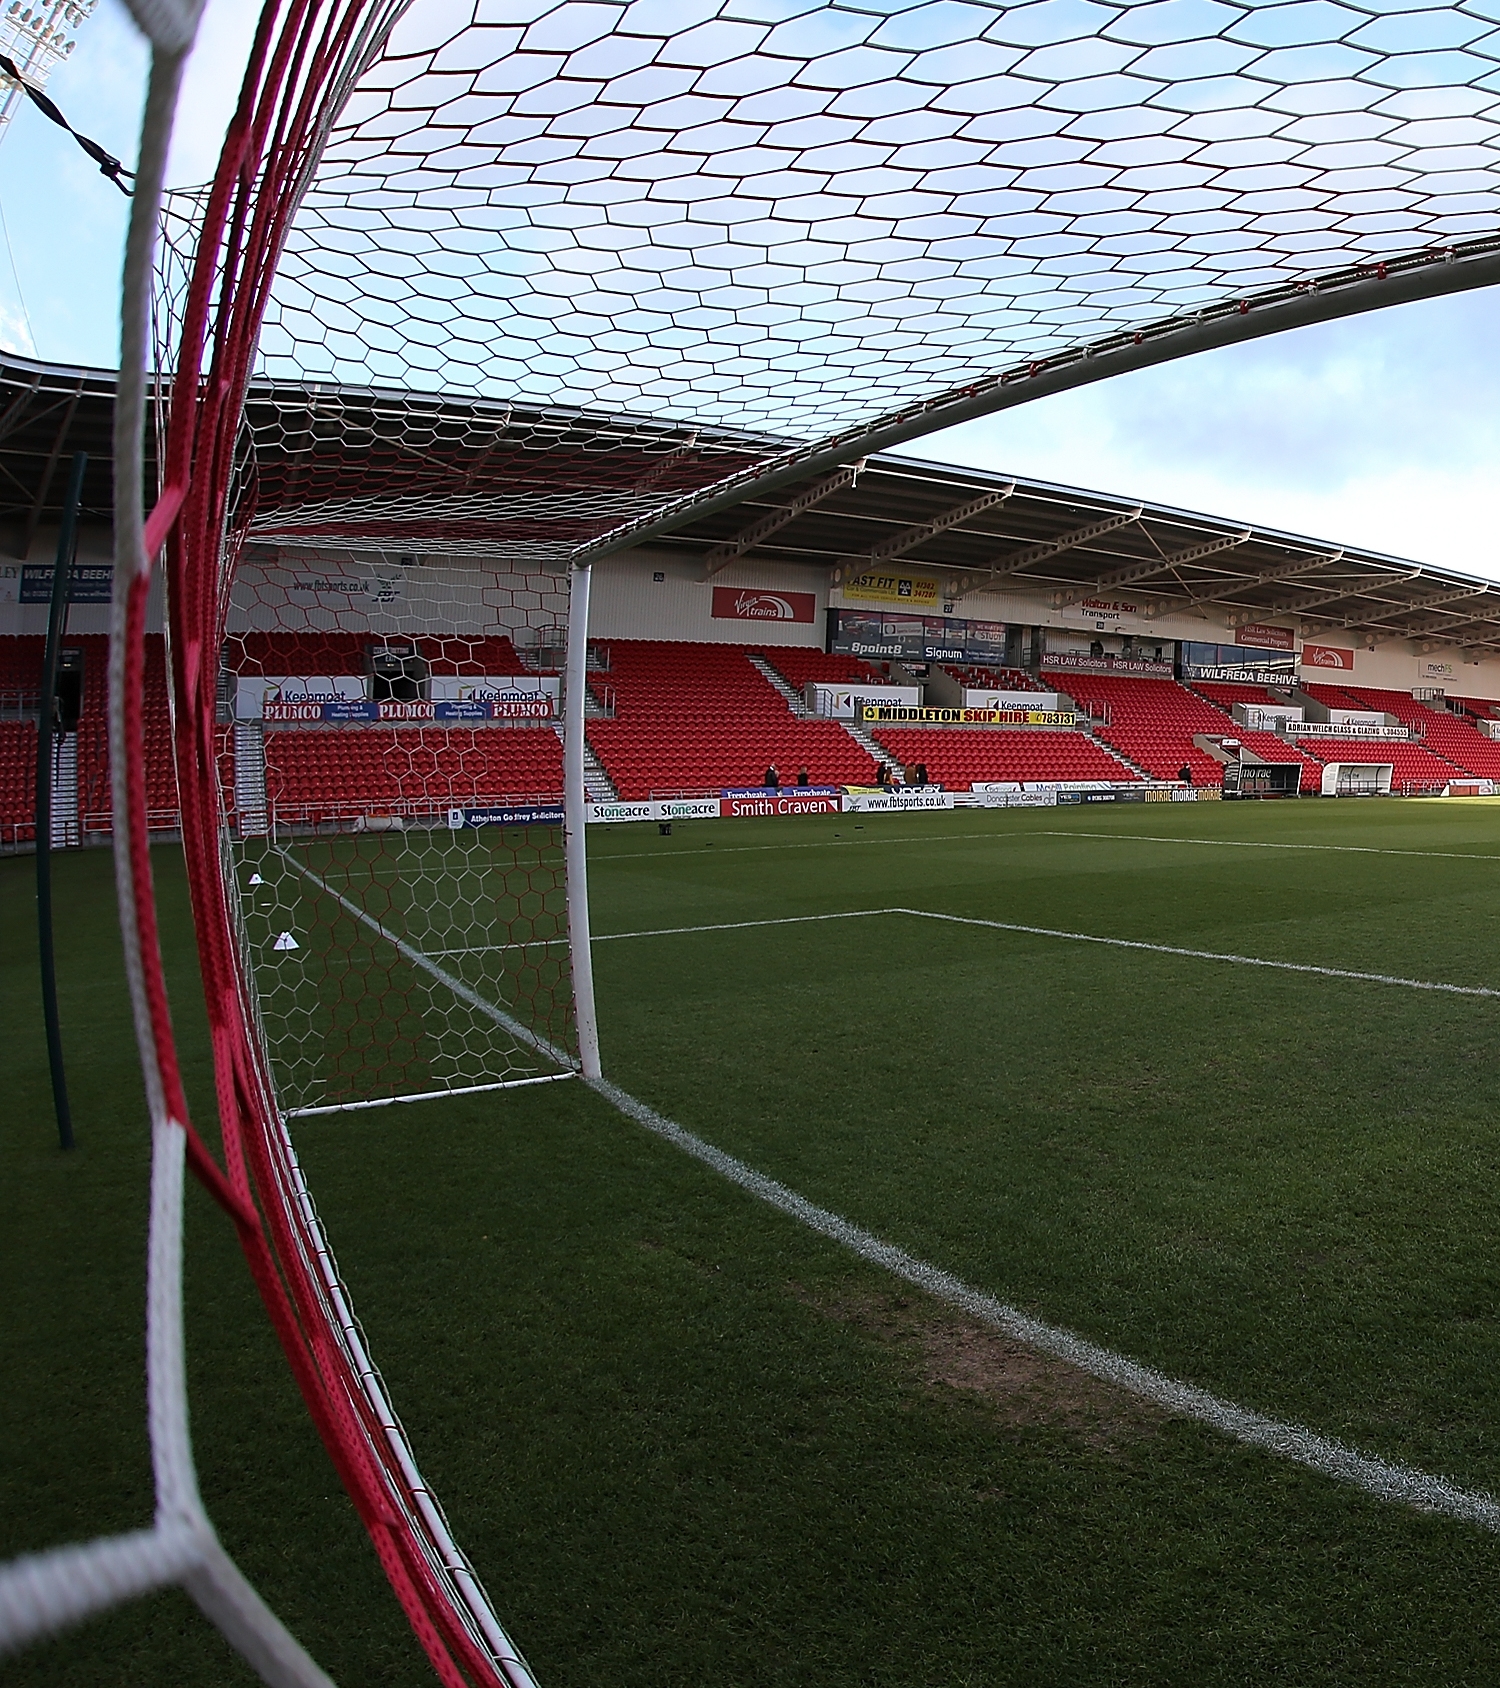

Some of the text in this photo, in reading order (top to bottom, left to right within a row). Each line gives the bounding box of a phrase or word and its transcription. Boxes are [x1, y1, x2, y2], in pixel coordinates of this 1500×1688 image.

[24, 569, 79, 579] WILFRA
[848, 575, 895, 588] AST FIT
[734, 591, 760, 616] Virgin
[1112, 601, 1119, 610] &
[1121, 602, 1137, 613] Son
[749, 606, 777, 617] trains
[1081, 608, 1121, 620] Transport
[851, 642, 903, 655] 8point8
[925, 646, 963, 659] Signum
[1043, 655, 1108, 669] HSR LAW Solicitors
[1112, 660, 1172, 674] HSR LAW Solicitors
[1200, 667, 1299, 686] WILFREDA BEEHIVE
[854, 696, 903, 707] Kepmoat
[264, 705, 322, 720] PLUMCO
[379, 703, 435, 719] PLUMCO
[493, 703, 549, 718] PLUMCO
[878, 707, 1075, 724] MIDDLETON SKIP HIRE 783731
[1288, 723, 1311, 732] ADRIAN
[1312, 724, 1332, 733] WELCH
[1333, 725, 1352, 733] GLASS
[1357, 726, 1380, 735] GLAZING
[1241, 768, 1272, 778] morae
[867, 795, 946, 809] www.fbtsports.co.uk
[1020, 793, 1043, 802] Cables
[1144, 790, 1172, 803] MOIRAE
[1172, 789, 1198, 802] MOIRAE
[1198, 789, 1223, 801] MOIRAE
[593, 805, 650, 818] Stoneacre
[660, 803, 716, 816] Stoneacre
[731, 798, 827, 817] Smith Craven
[502, 812, 531, 822] Gofrey
